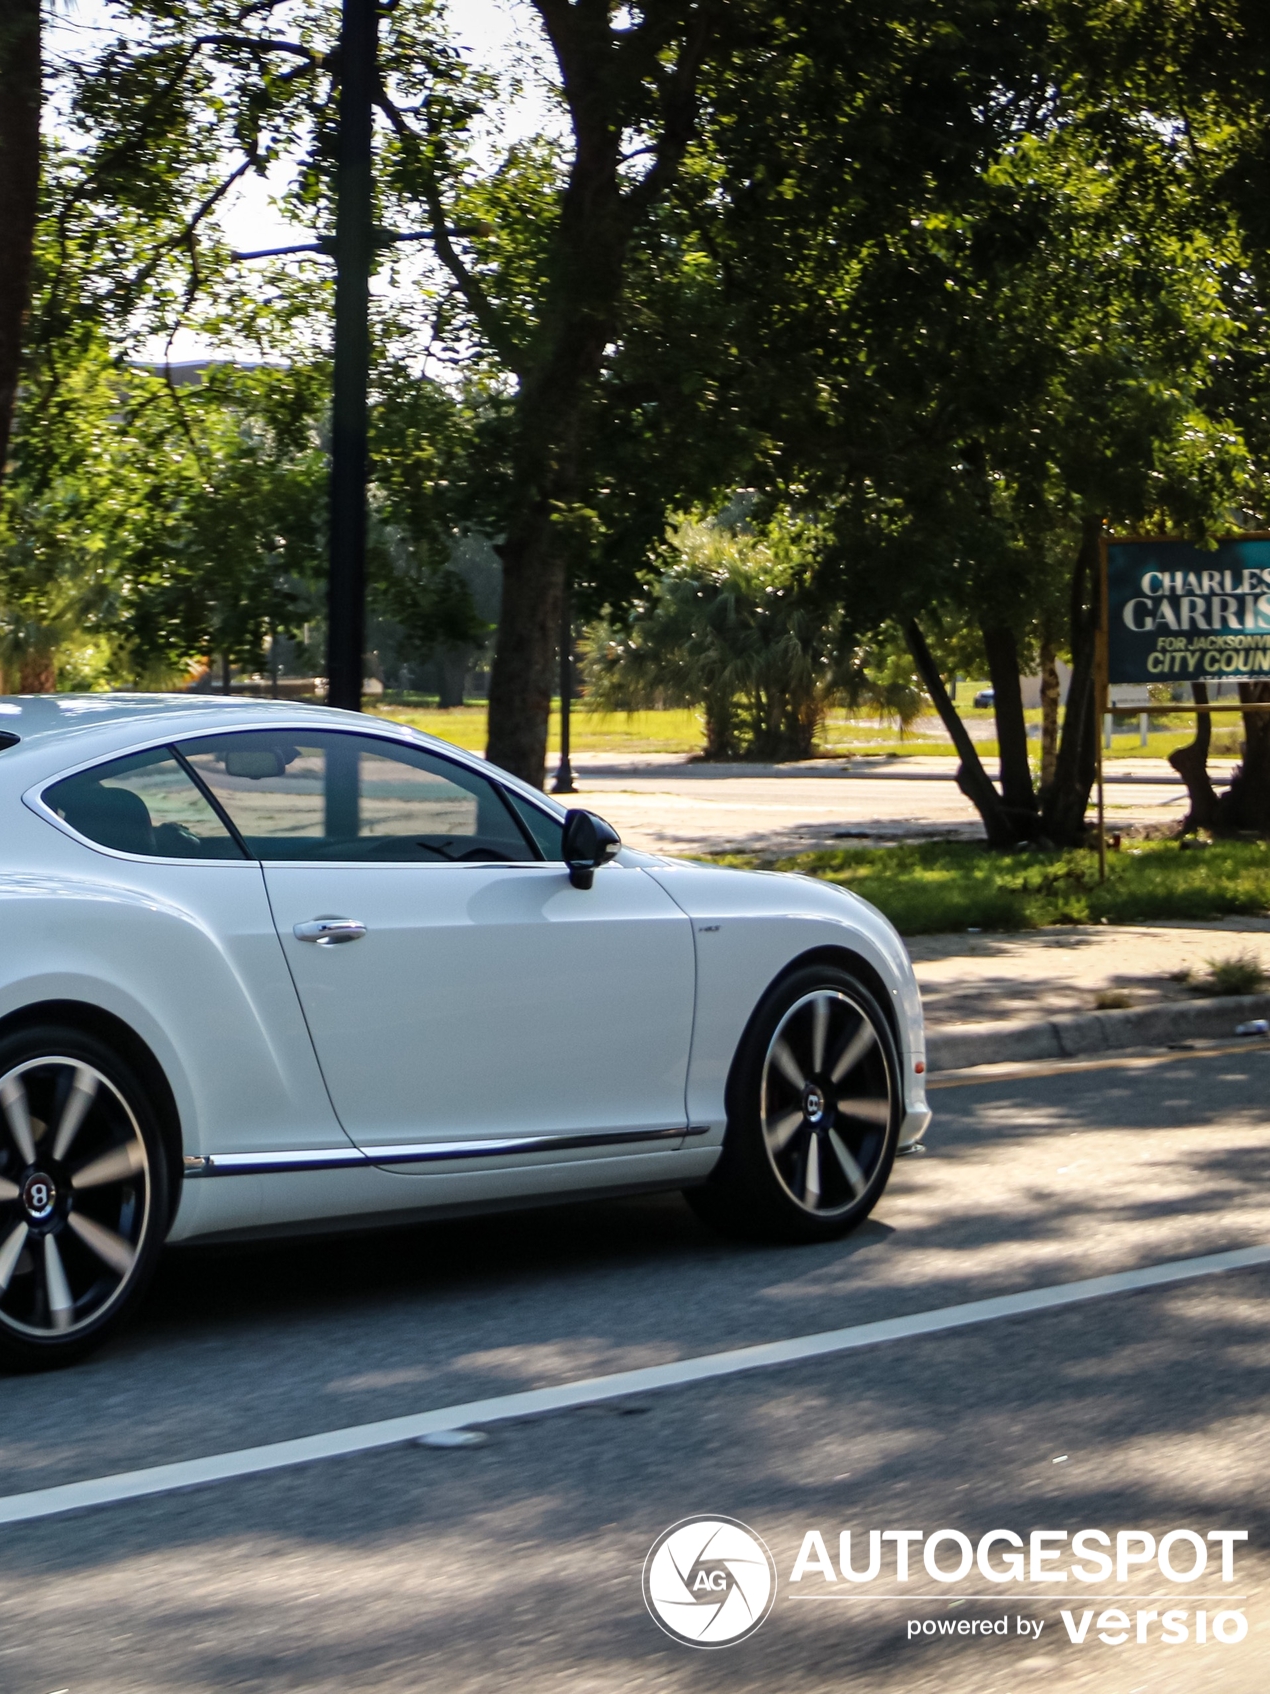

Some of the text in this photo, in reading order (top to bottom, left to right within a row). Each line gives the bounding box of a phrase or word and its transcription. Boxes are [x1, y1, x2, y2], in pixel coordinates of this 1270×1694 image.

[1141, 568, 1270, 596] CHARLES
[1157, 637, 1187, 650] FOR
[1146, 651, 1201, 673] CITY
